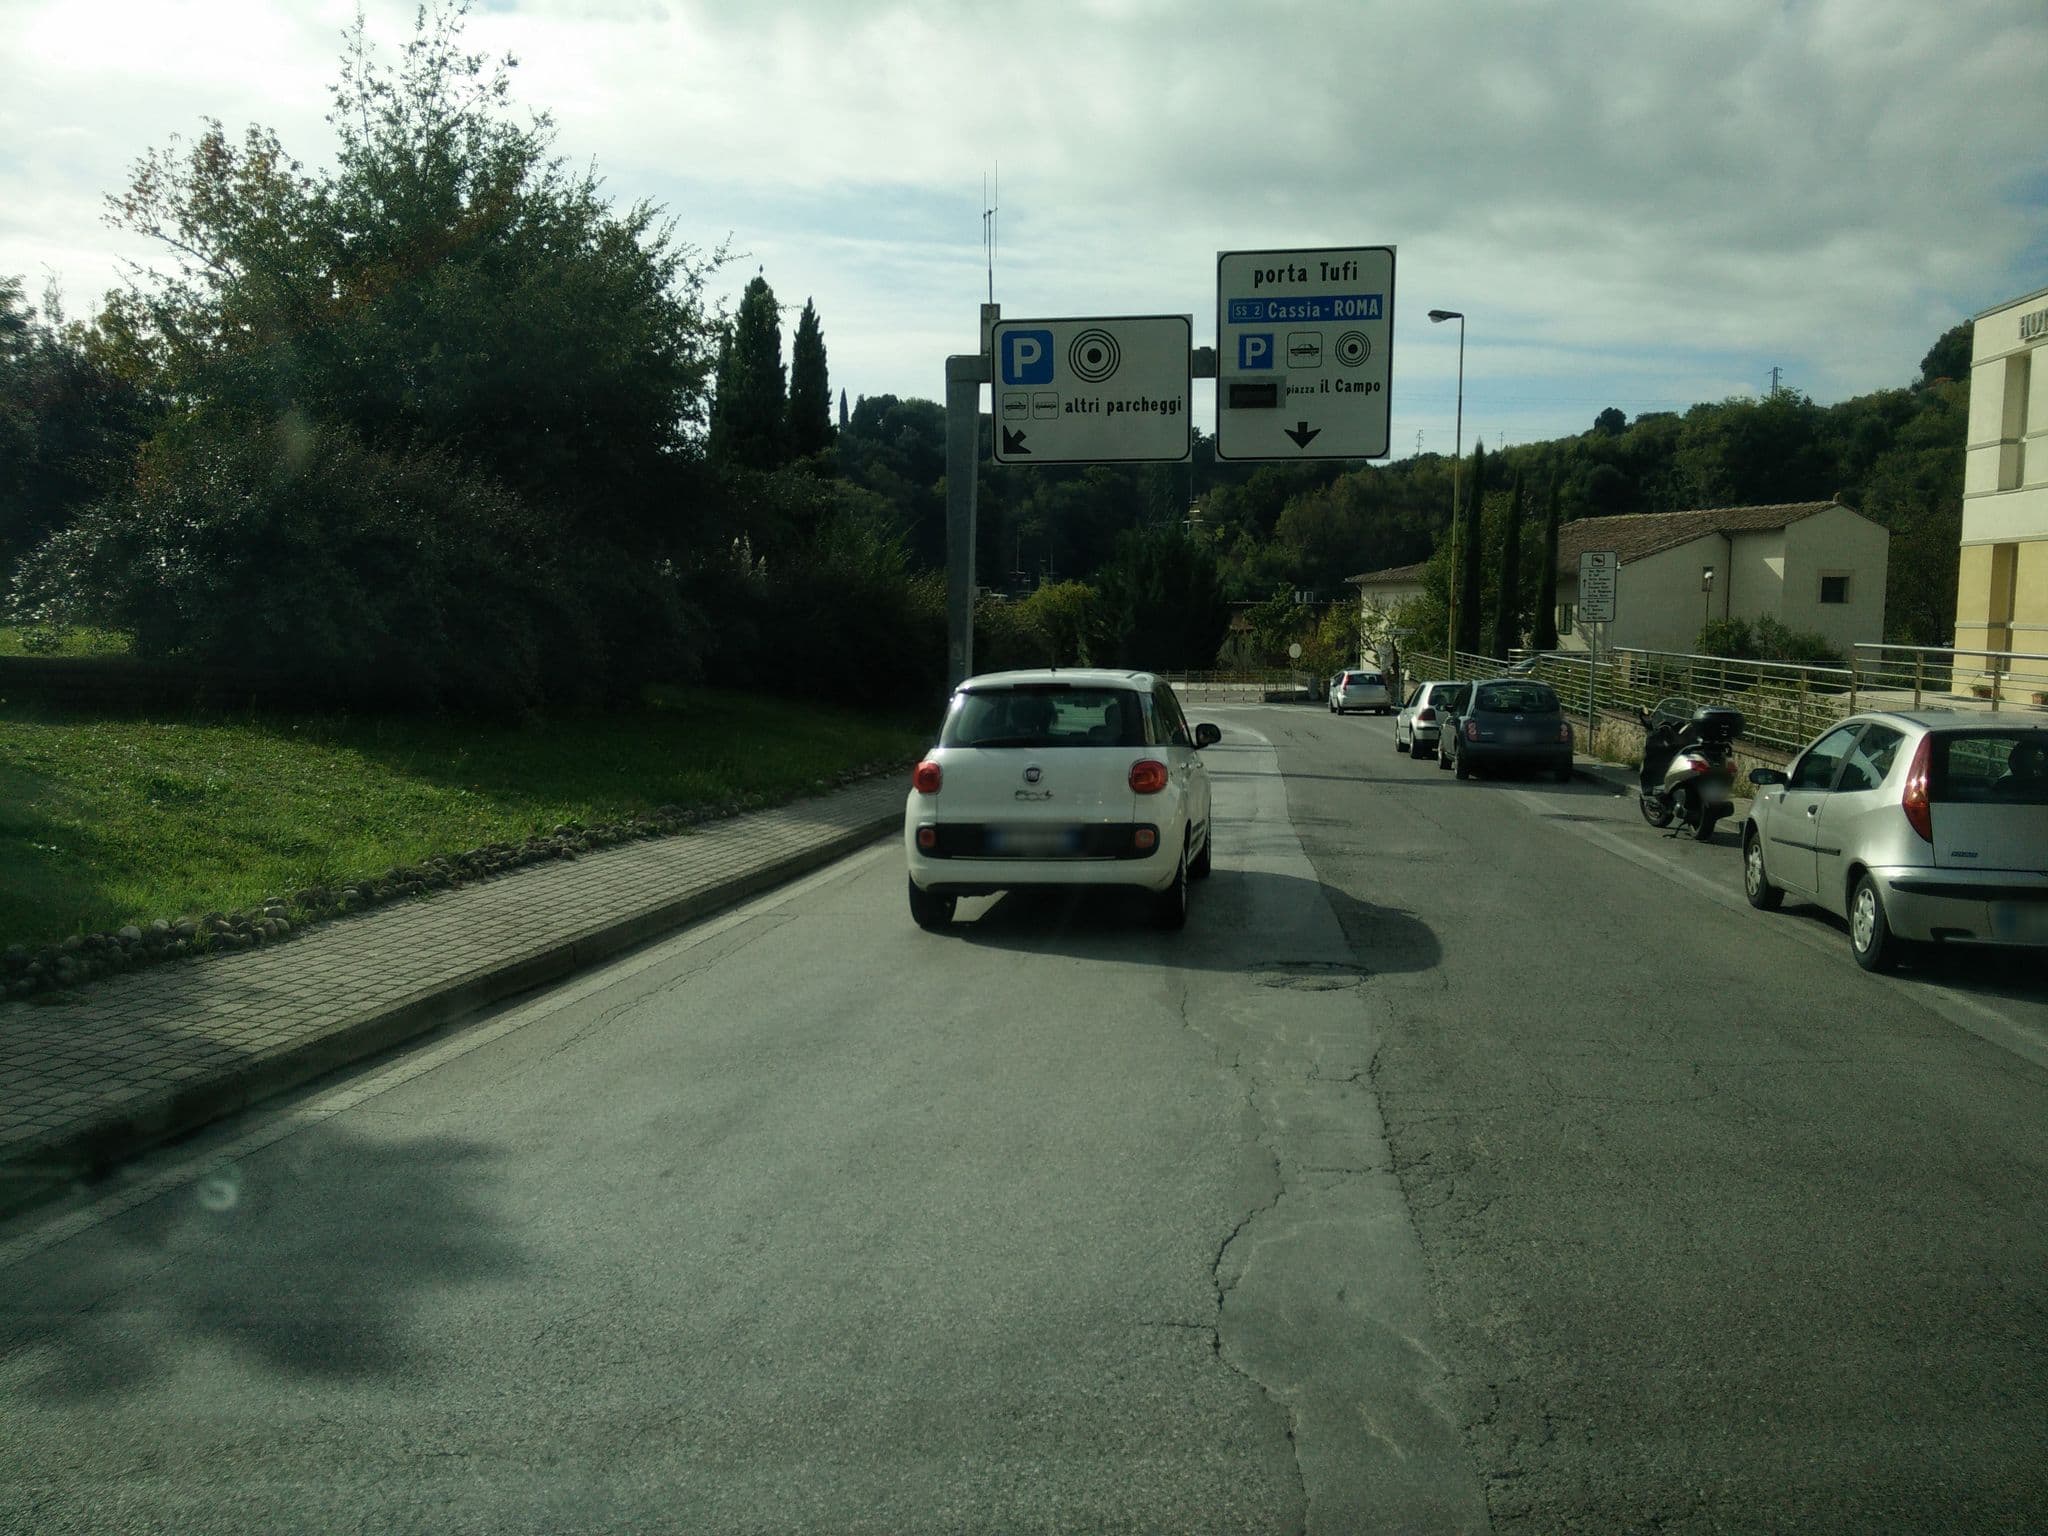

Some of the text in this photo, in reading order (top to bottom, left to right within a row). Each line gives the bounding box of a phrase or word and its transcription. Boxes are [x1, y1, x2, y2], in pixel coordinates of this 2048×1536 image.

[1254, 261, 1358, 288] porta Tufi
[1235, 306, 1260, 316] SS 2
[1268, 302, 1321, 318] Cassia
[1334, 299, 1379, 317] ROMA
[1013, 337, 1042, 378] P
[1245, 338, 1267, 366] P
[1286, 378, 1381, 396] piazza il Campo
[1065, 396, 1181, 416] altri parcheggi
